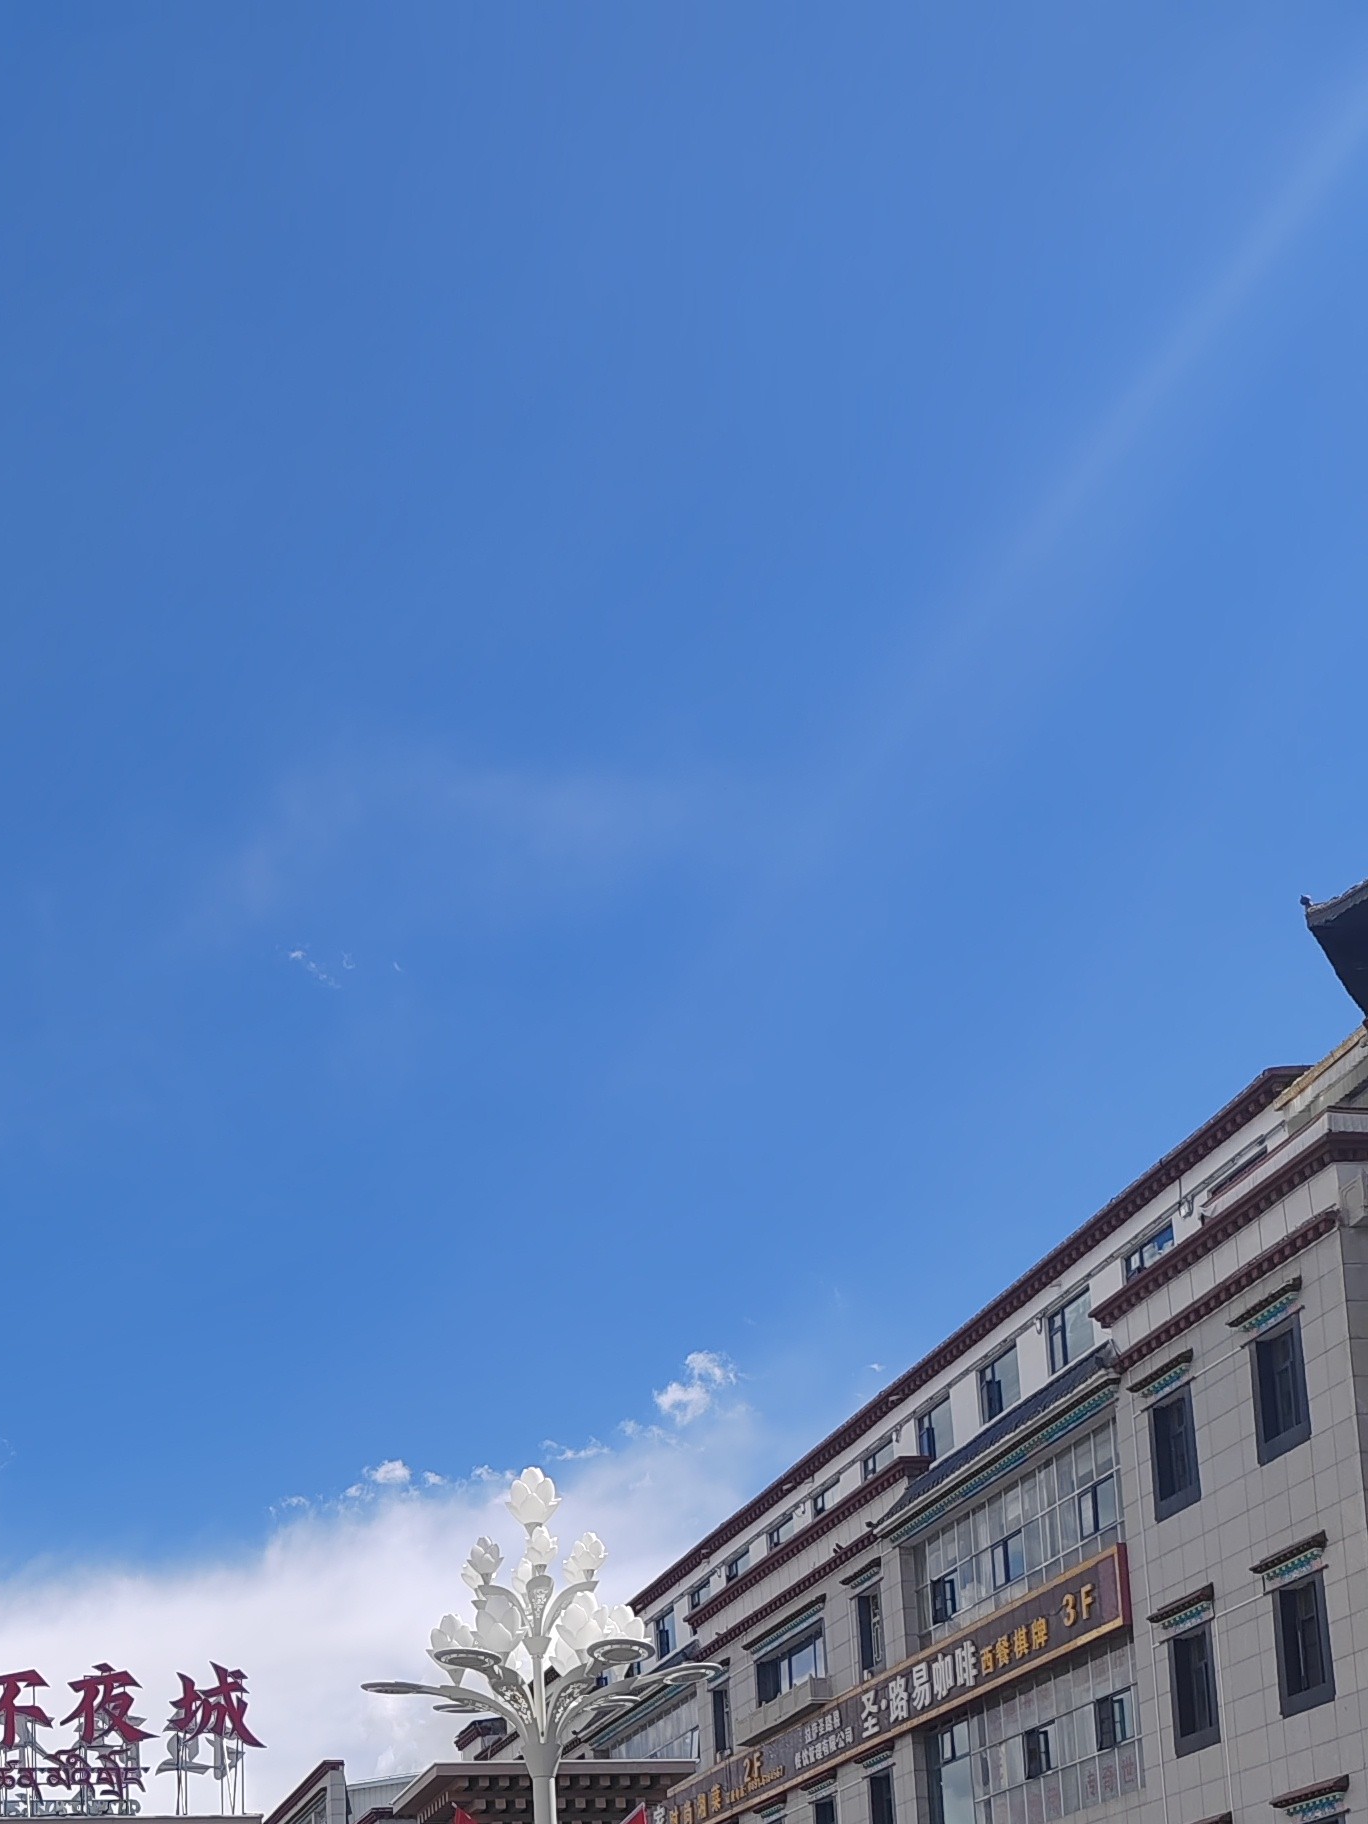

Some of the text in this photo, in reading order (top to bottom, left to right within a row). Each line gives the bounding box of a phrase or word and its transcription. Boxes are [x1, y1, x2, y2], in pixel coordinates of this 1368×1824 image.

[1062, 1583, 1096, 1627] 3F
[861, 1617, 1048, 1739] 圣·路易咖啡 西餐棋牌
[742, 1750, 764, 1784] 2F
